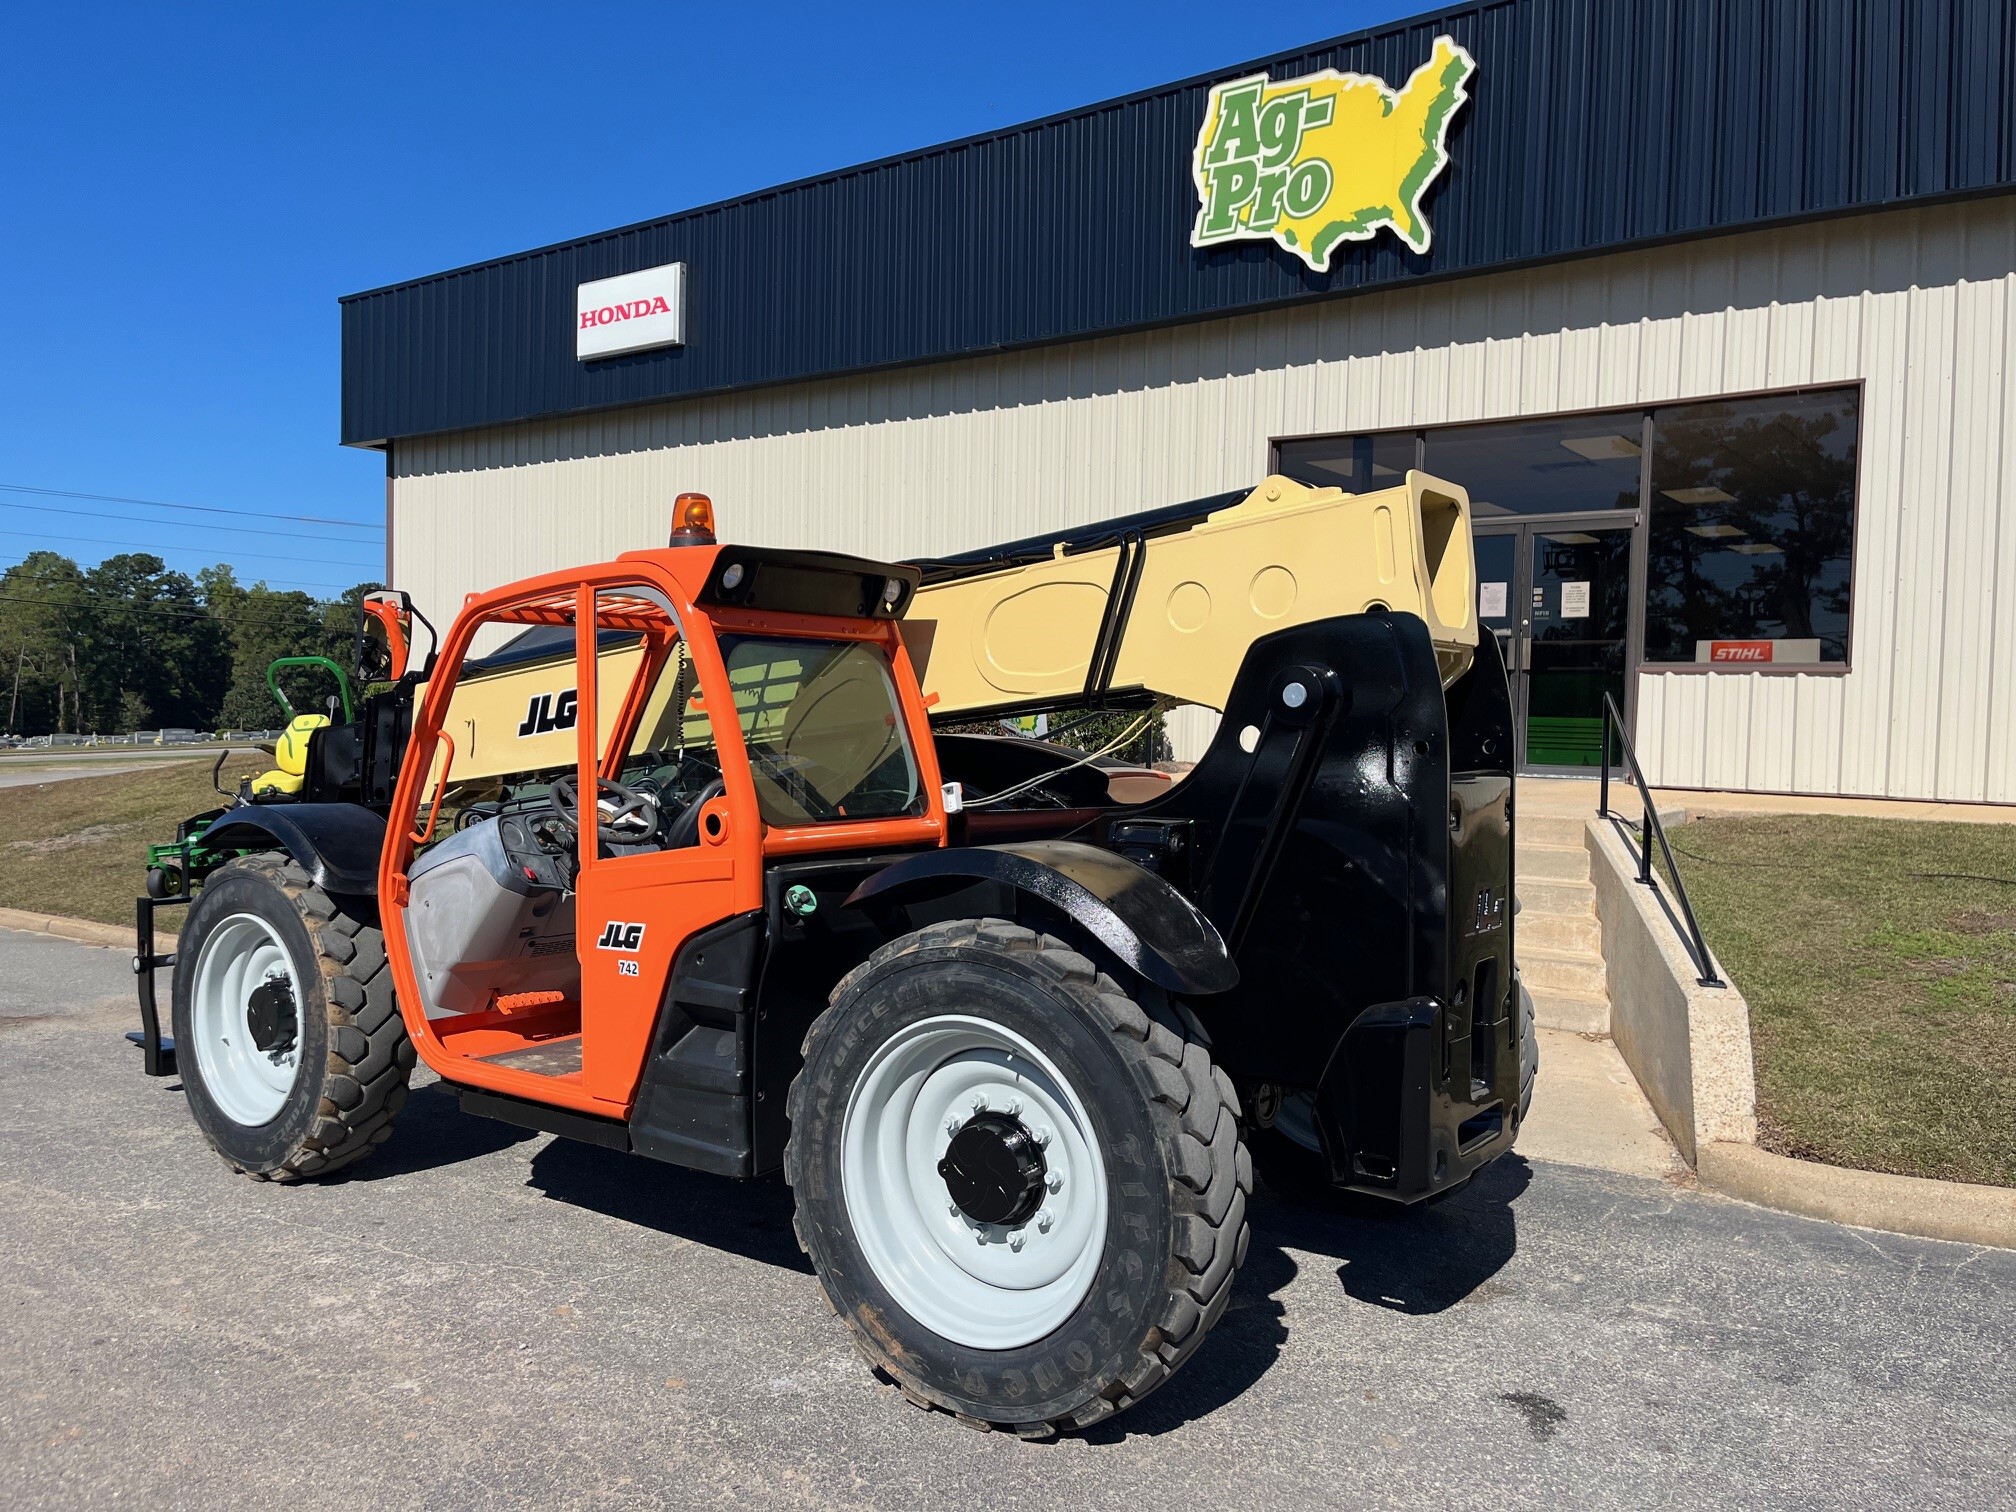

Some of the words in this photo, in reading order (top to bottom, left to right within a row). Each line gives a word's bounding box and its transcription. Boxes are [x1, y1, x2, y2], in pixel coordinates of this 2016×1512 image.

[1203, 82, 1335, 169] Ag-
[1201, 158, 1332, 238] Pro
[580, 296, 670, 329] HONDA
[1714, 648, 1764, 660] STIHL
[518, 688, 577, 738] JLG
[598, 922, 645, 951] JLG
[619, 961, 638, 975] 742
